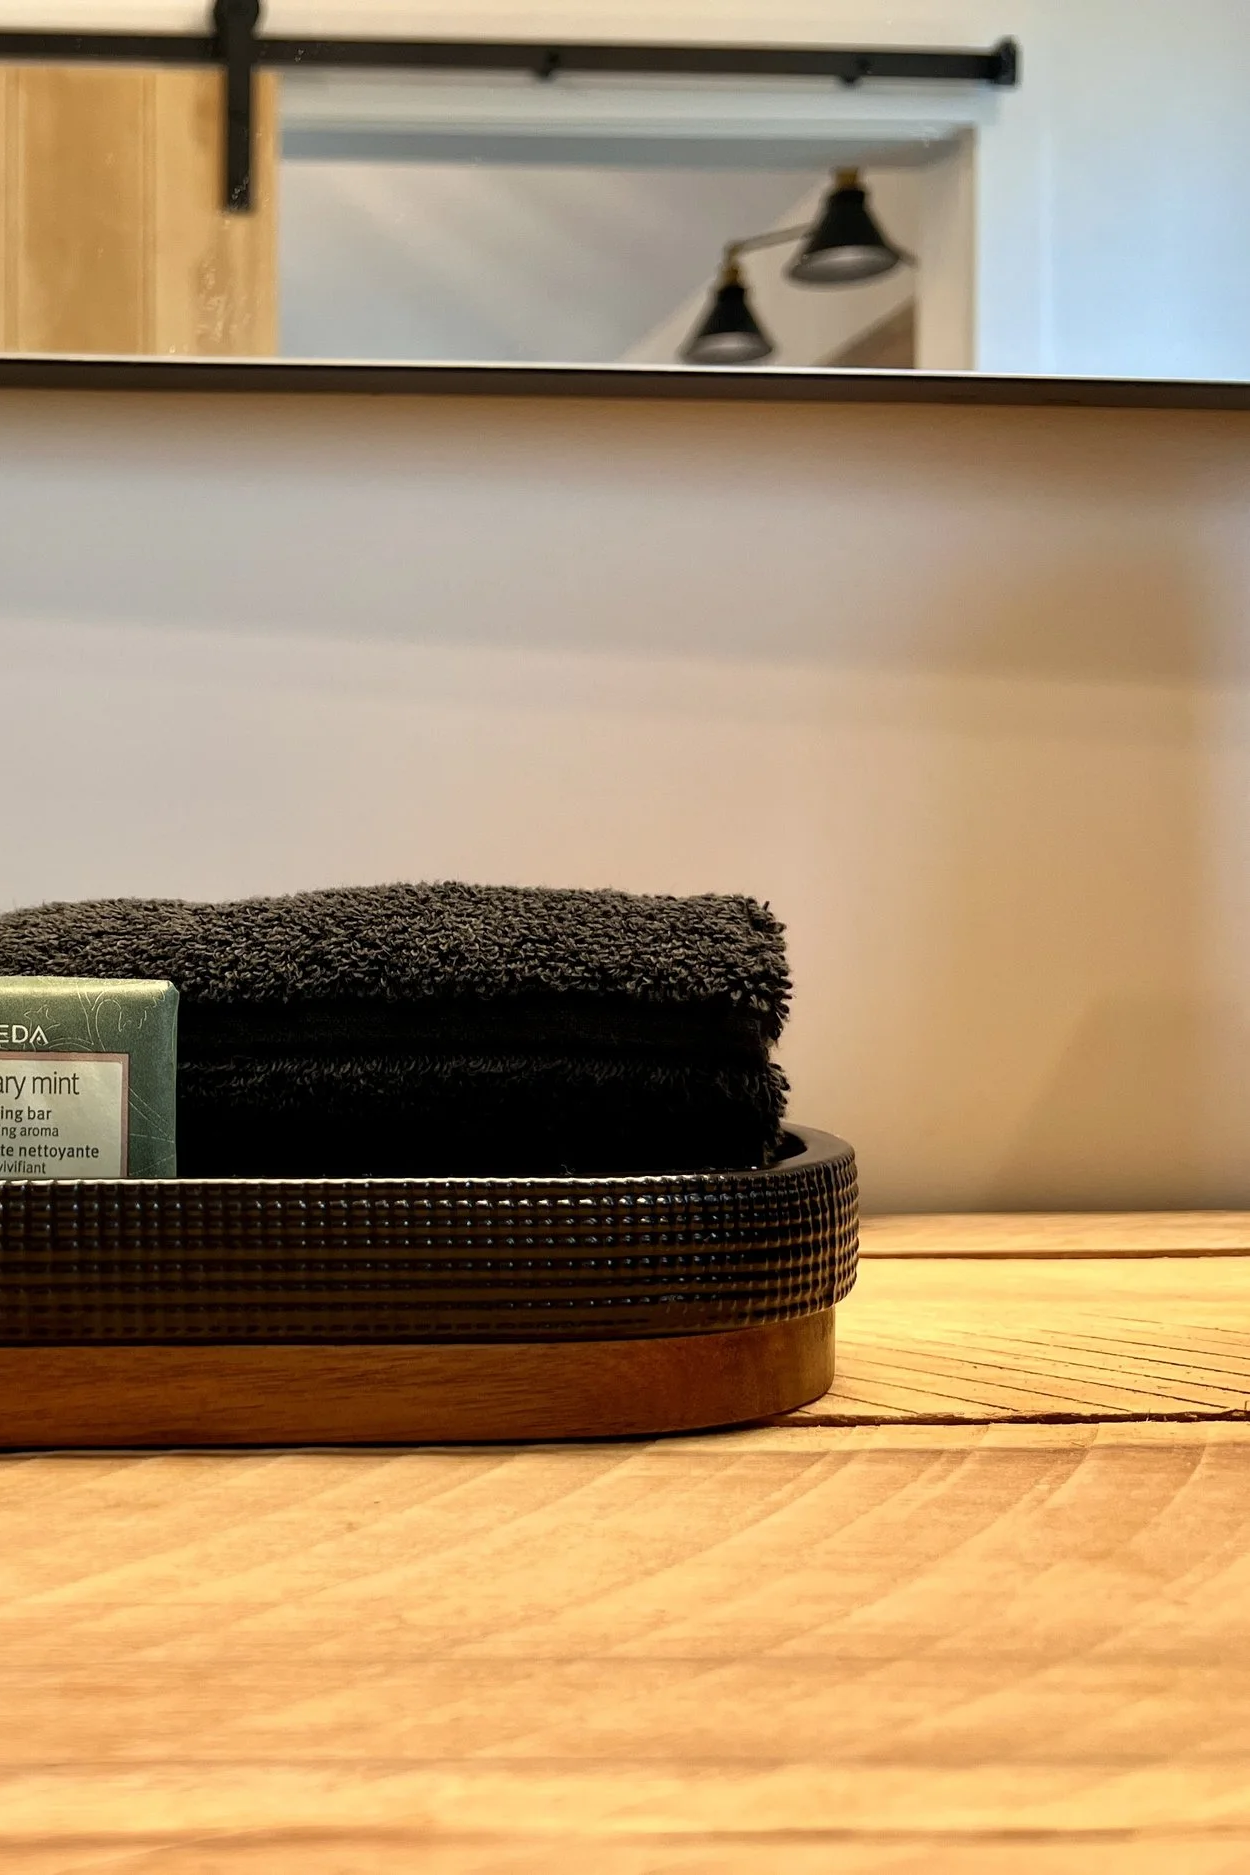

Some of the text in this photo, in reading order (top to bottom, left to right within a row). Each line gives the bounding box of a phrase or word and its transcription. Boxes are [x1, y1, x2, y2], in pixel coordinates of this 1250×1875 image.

[32, 1071, 80, 1095] mint
[28, 1106, 52, 1120] bar
[20, 1126, 59, 1137] aroma
[18, 1145, 100, 1161] nettoyante
